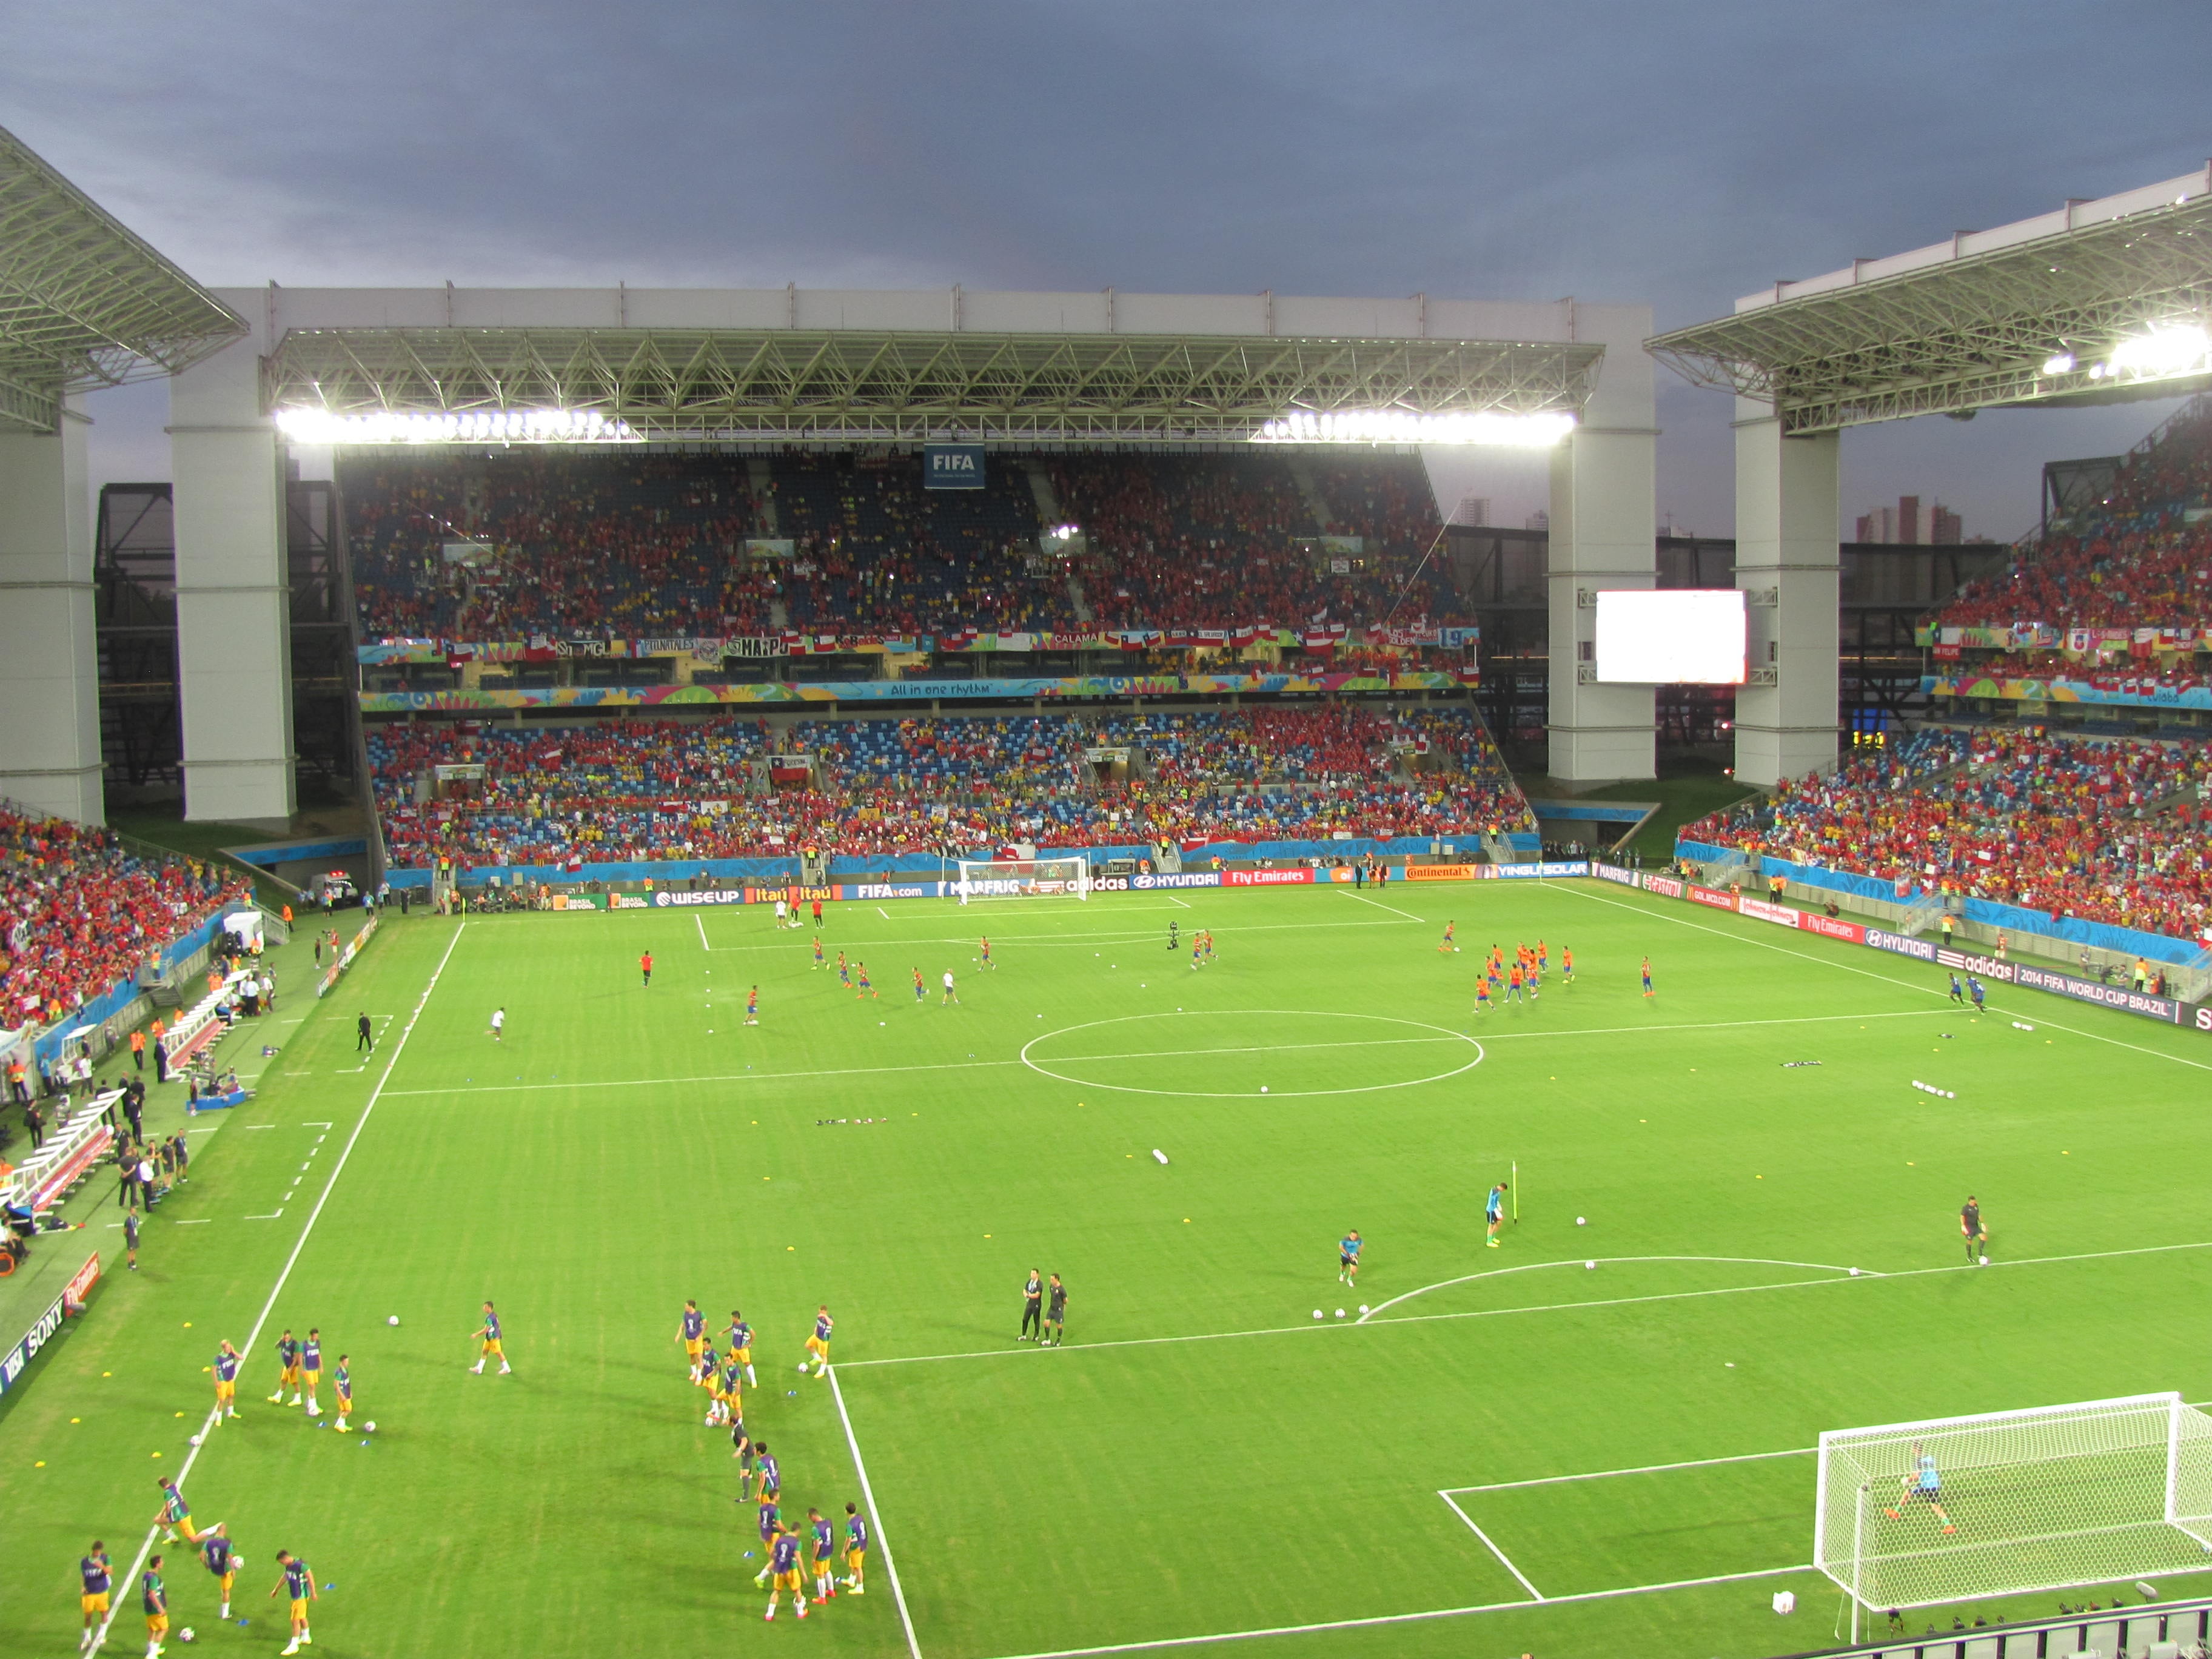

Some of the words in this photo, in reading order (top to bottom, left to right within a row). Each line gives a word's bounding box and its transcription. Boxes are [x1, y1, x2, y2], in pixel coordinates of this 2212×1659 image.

[933, 454, 975, 470] FIFA
[1055, 633, 1097, 643] CALAMA
[891, 685, 906, 695] All
[910, 684, 921, 695] in
[925, 685, 947, 695] one
[1406, 867, 1461, 879] Continental
[1498, 865, 1540, 876] YINGLI
[1543, 863, 1586, 875] SOLAR
[1599, 865, 1629, 884] MARFRIG
[1066, 876, 1128, 892] adidas
[1157, 874, 1219, 887] HYUNDAI
[1232, 871, 1252, 885] Fly
[1254, 871, 1304, 883] Emirates
[756, 888, 788, 902] Itaú
[800, 885, 831, 900] Itaú
[950, 879, 1019, 895] MARFRIG
[1808, 915, 1820, 933] Fly
[1821, 918, 1853, 938] Emirates
[1883, 934, 1932, 959] HYUNDAI
[1965, 955, 2012, 980] adidas
[2020, 968, 2042, 986] 2014
[2043, 973, 2065, 991] FIFA
[2066, 979, 2104, 1000] WORLD
[2105, 989, 2127, 1007] CUP
[2129, 994, 2168, 1016] BRAZIL
[27, 1298, 64, 1358] SONY
[4, 1347, 25, 1383] VISA
